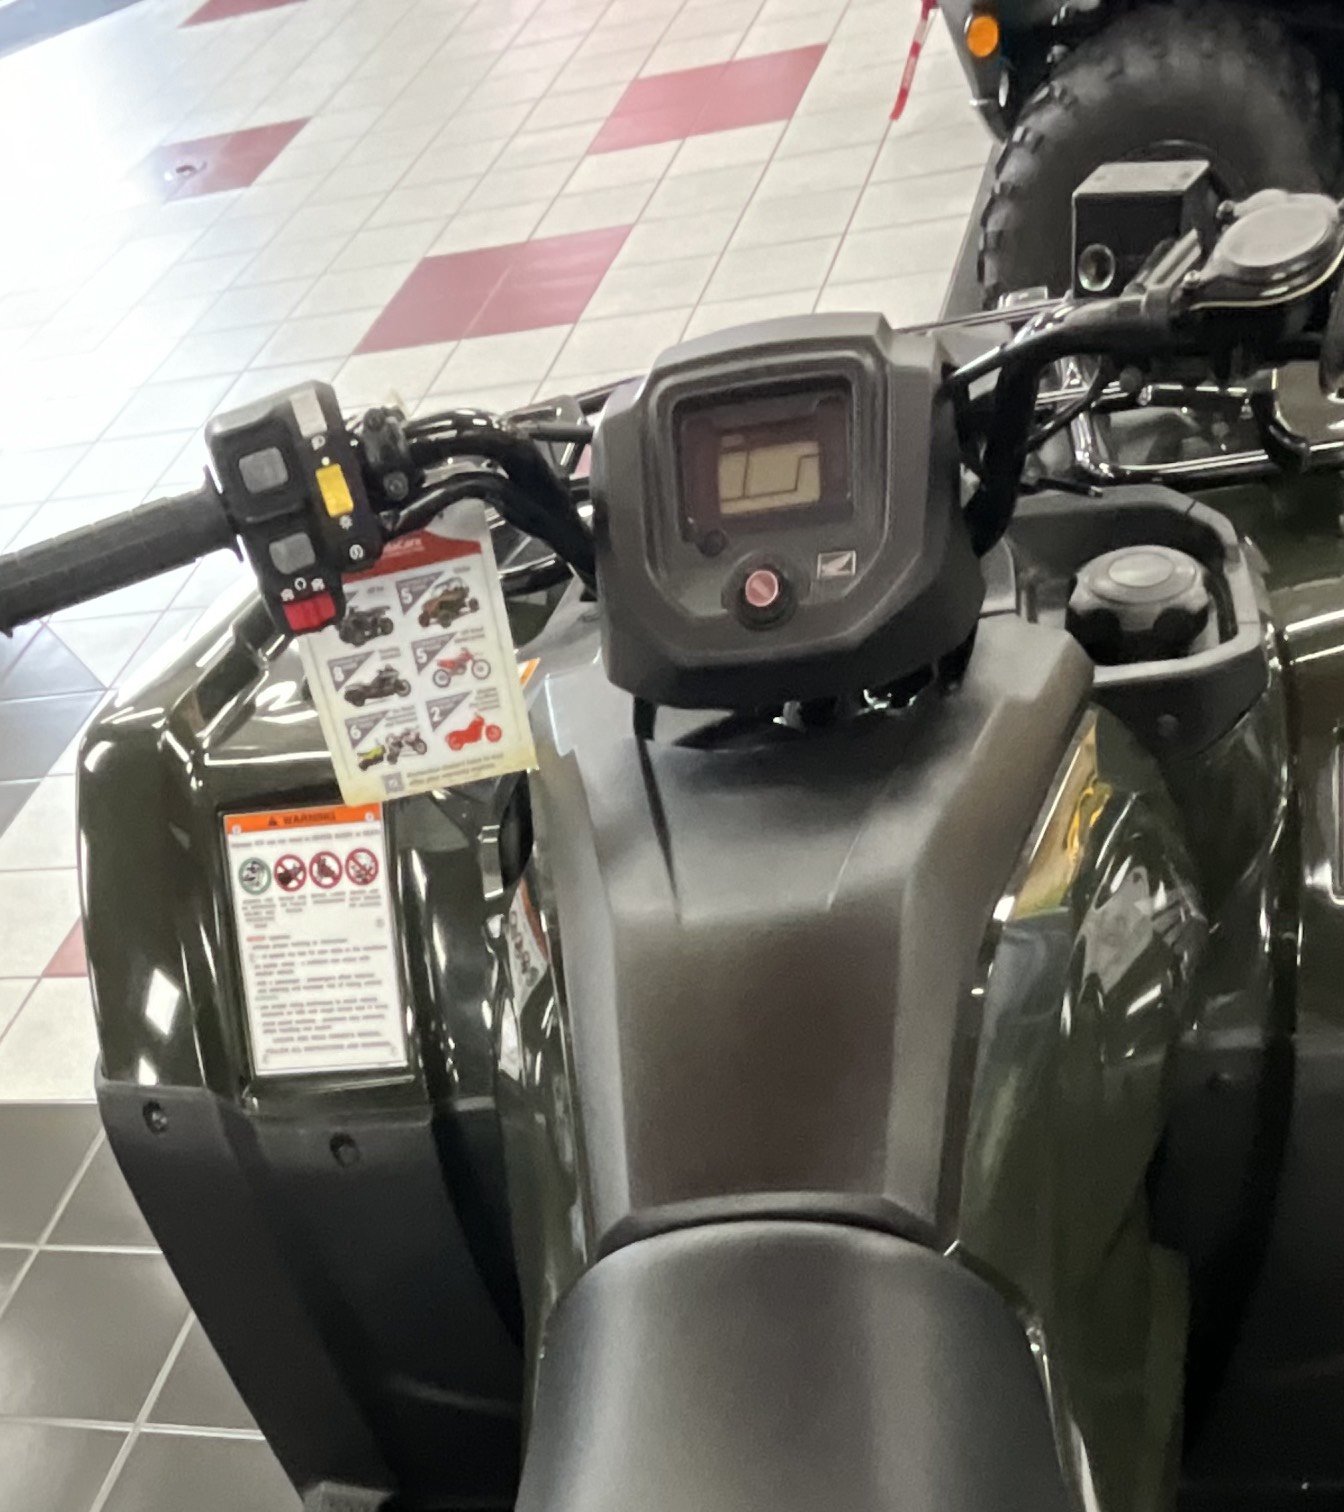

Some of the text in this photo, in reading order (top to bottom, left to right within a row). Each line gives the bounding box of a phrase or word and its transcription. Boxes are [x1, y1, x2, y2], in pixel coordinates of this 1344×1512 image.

[401, 588, 412, 604] 5
[416, 648, 427, 663] 5
[430, 706, 441, 722] 2
[350, 725, 361, 739] 6
[283, 812, 336, 825] WARNING
